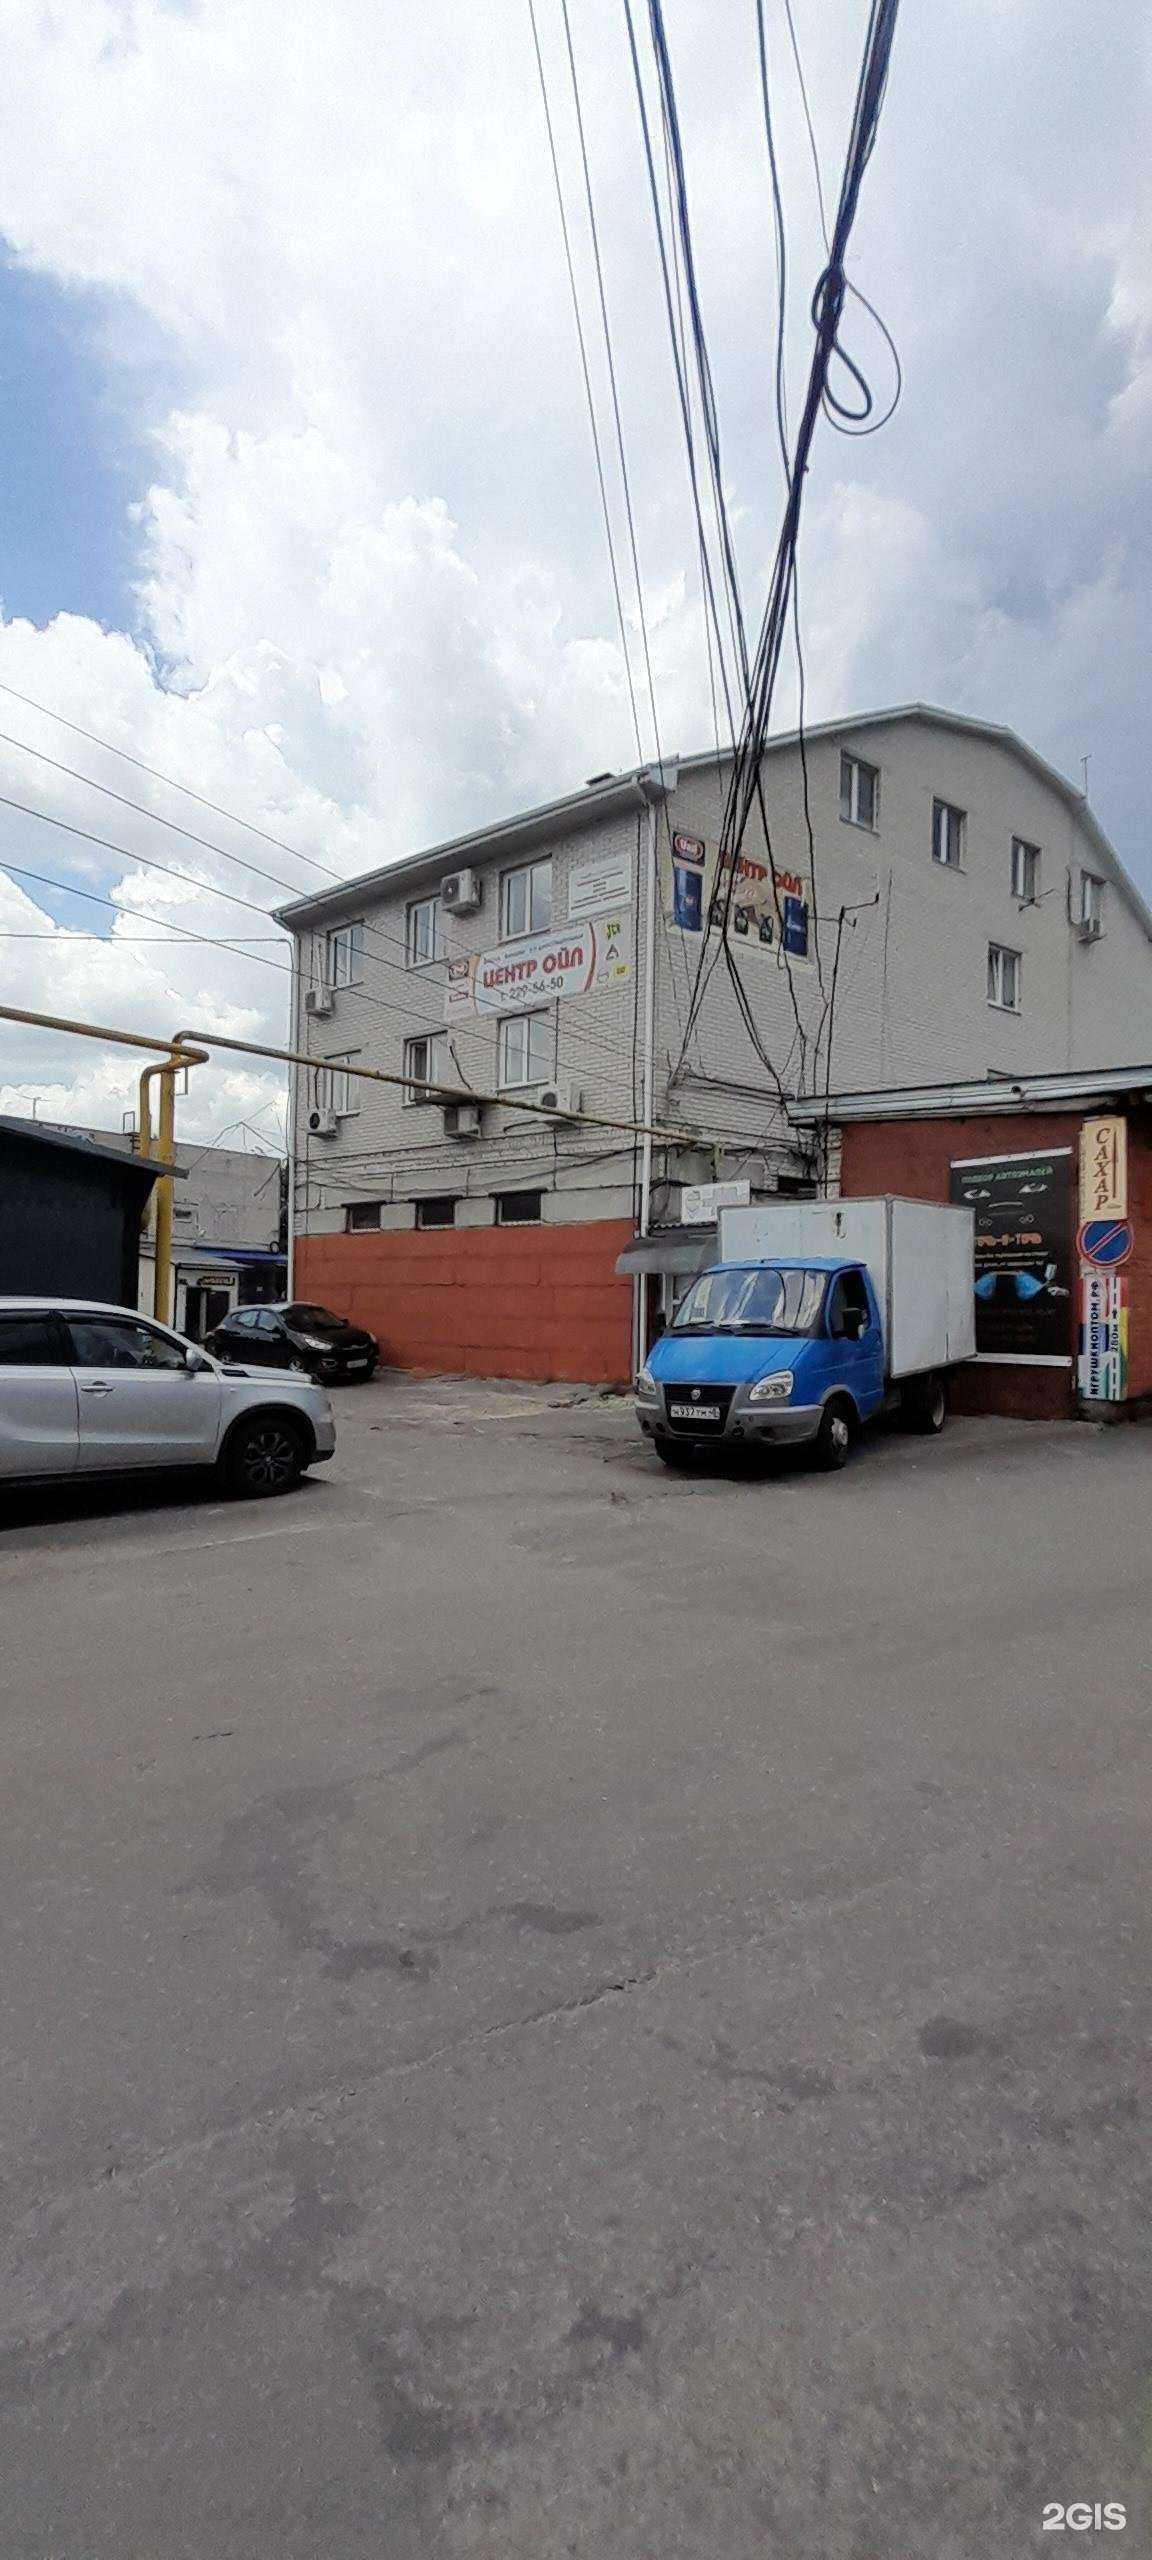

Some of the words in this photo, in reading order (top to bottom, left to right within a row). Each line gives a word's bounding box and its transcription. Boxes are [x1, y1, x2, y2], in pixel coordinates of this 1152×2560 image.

[483, 959, 538, 988] ЦЕНТР
[543, 945, 584, 973] ОЙЛ
[1092, 1127, 1112, 1211] САХАР
[1090, 1281, 1099, 1396] ИГРУШКИОПТОМ.РФ
